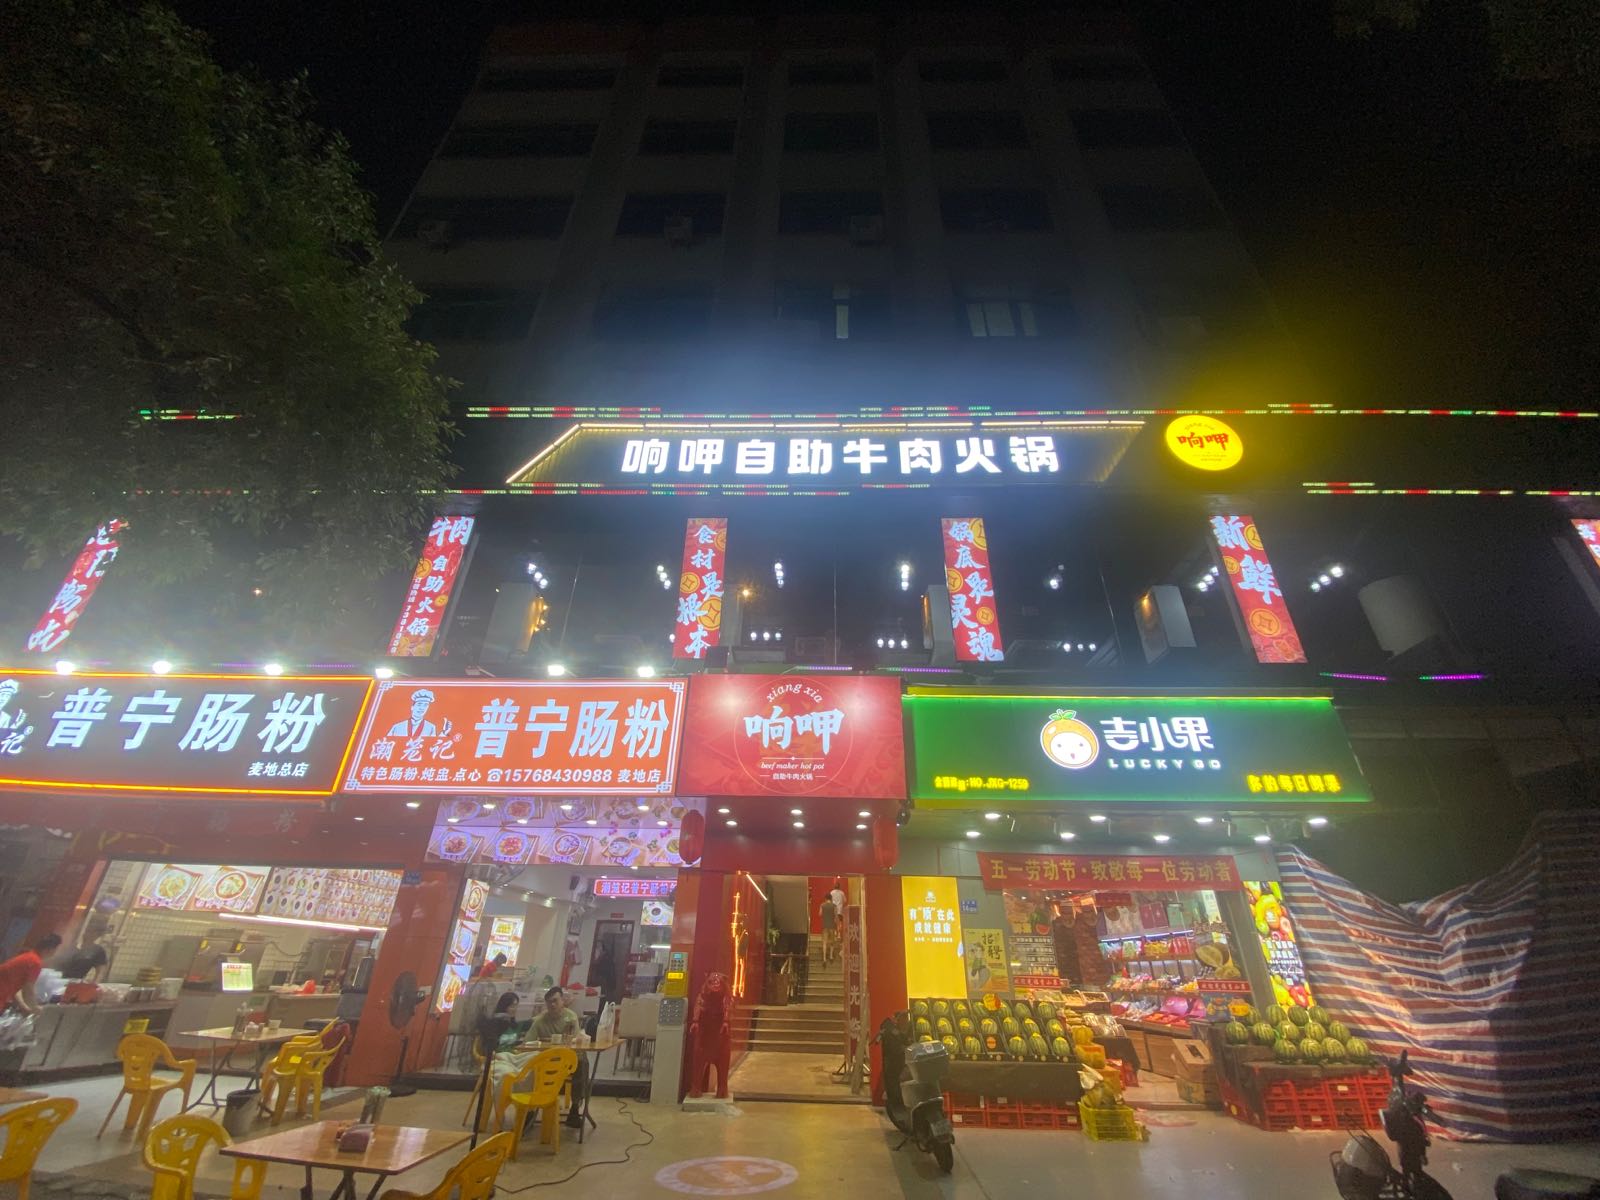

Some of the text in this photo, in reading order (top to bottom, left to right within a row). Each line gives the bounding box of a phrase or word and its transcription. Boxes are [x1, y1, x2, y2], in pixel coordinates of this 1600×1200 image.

[621, 436, 1058, 475] 响呷自助牛肉火锅
[429, 516, 475, 546] 牛肉
[1210, 515, 1282, 604] 新鲜
[407, 555, 448, 637] 自助火锅
[677, 524, 724, 659] 食材是根本
[767, 683, 823, 703] xiang xia
[47, 687, 326, 754] 普宁肠粉
[474, 698, 669, 759] 普宁肠粉
[743, 705, 845, 755] 响呷
[1100, 716, 1215, 752] 吉小果
[248, 762, 310, 777] 麦地总店
[504, 769, 612, 783] 15768430988
[617, 769, 661, 783] 麦地店
[813, 763, 825, 771] pot
[1108, 759, 1183, 770] LUCKY
[981, 931, 1004, 960] 招聘
